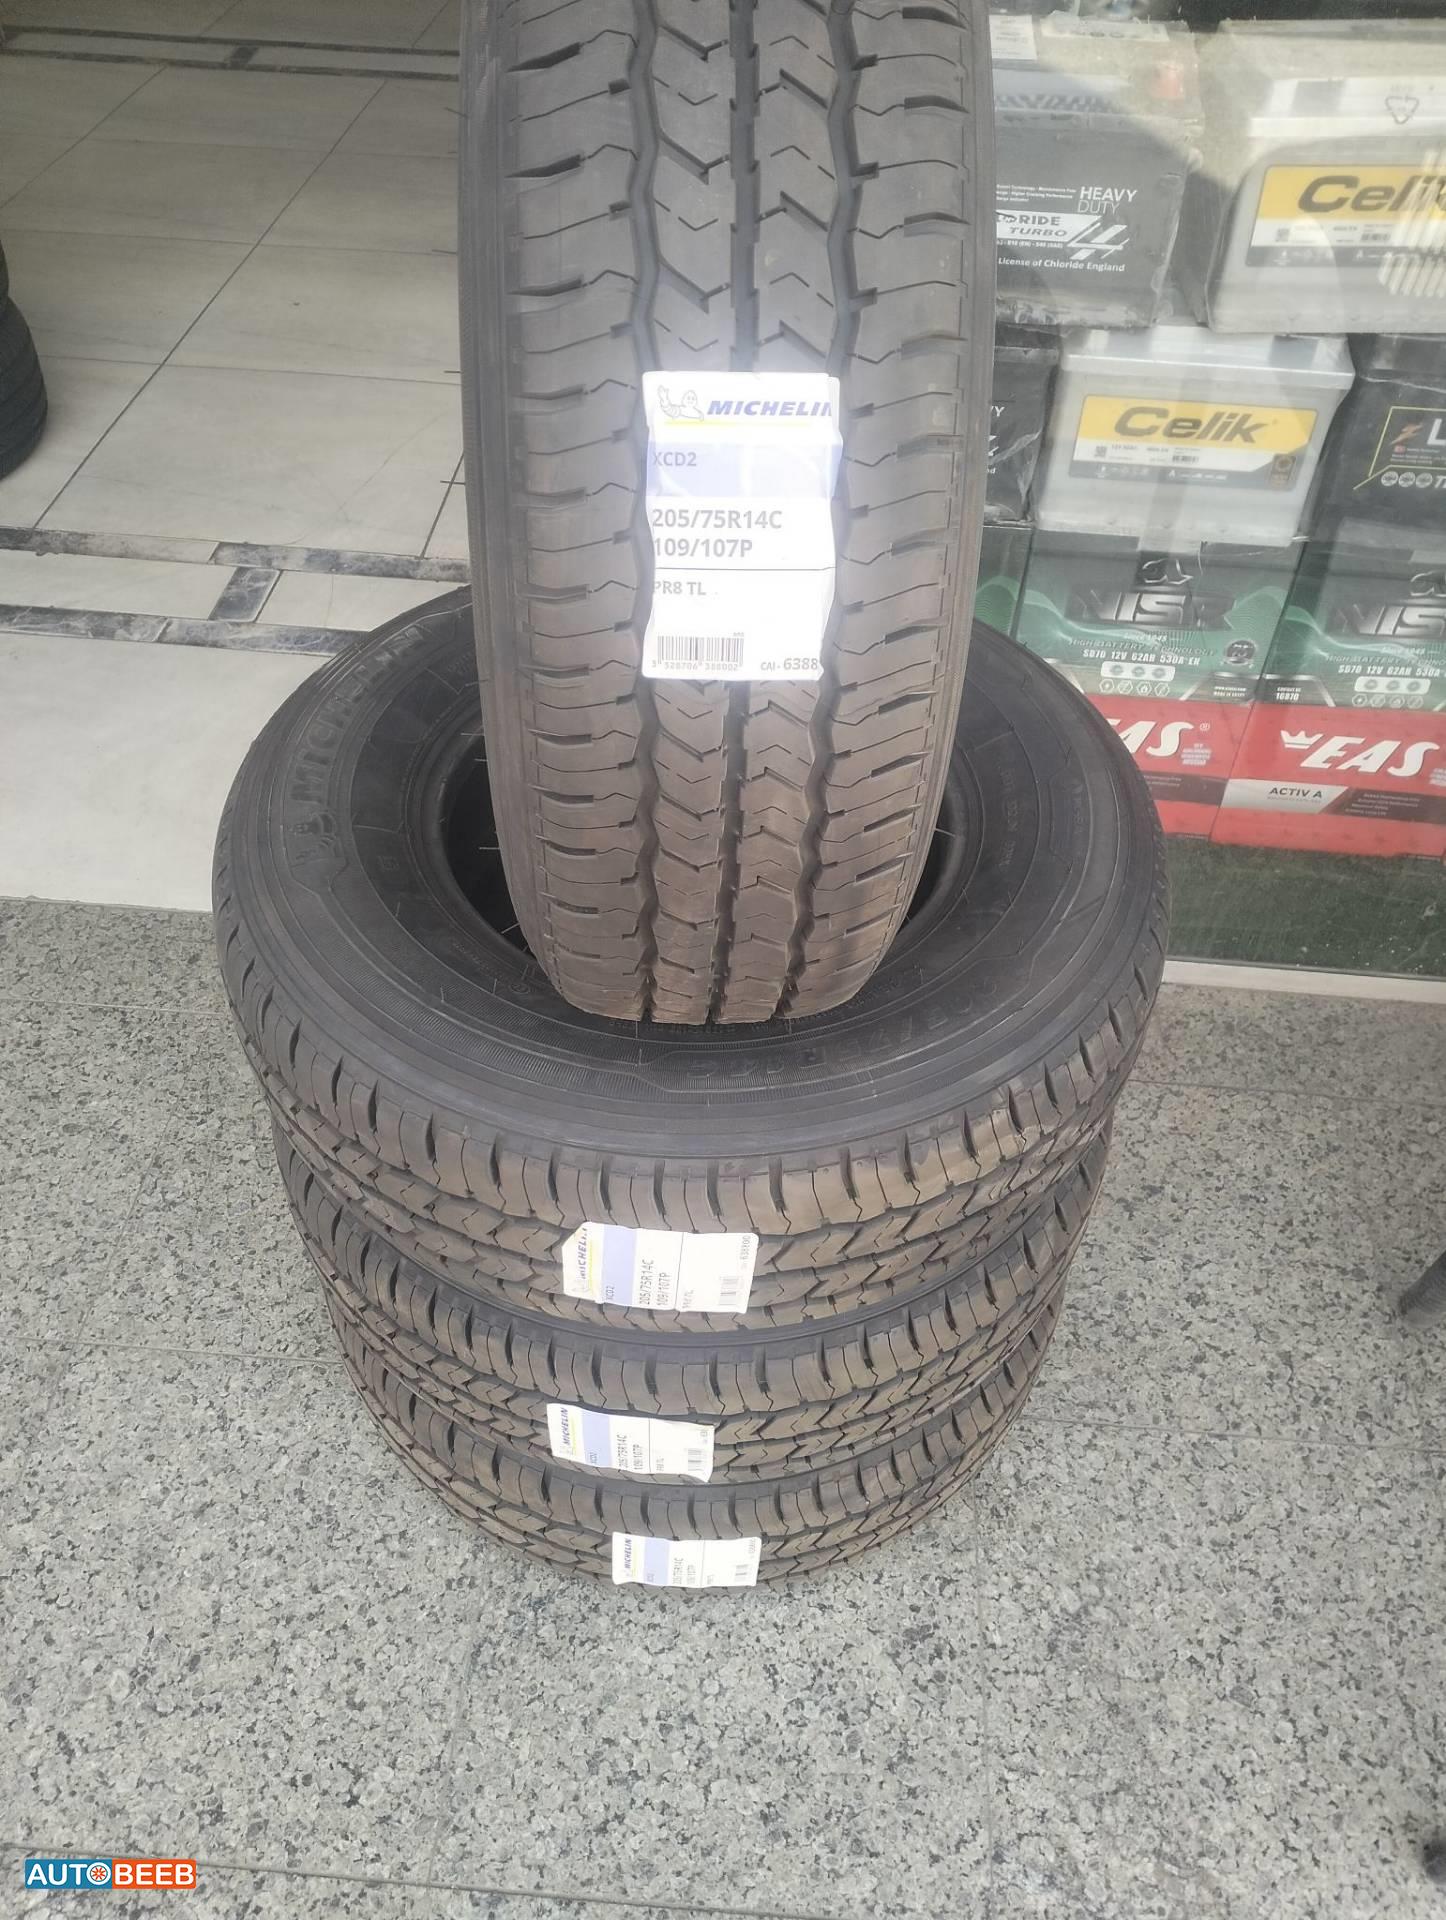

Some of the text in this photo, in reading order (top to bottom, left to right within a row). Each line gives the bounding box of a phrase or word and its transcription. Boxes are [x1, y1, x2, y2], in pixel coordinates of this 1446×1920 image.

[1080, 186, 1138, 202] HEAVY
[1077, 199, 1120, 215] DUTY
[1009, 226, 1068, 237] TURBO
[998, 257, 1126, 272] License of Chloride England
[1114, 406, 1270, 443] Celik
[653, 452, 697, 467] XCD2
[652, 509, 783, 529] 205/75R14C
[654, 538, 753, 558] 109/107P
[687, 582, 707, 596] TL
[1111, 650, 1128, 660] 12V
[783, 658, 818, 671] 6388
[1367, 666, 1384, 675] 12V
[1106, 718, 1195, 757] AS
[1300, 735, 1440, 777] EAS
[1268, 787, 1323, 799] ACTIV A
